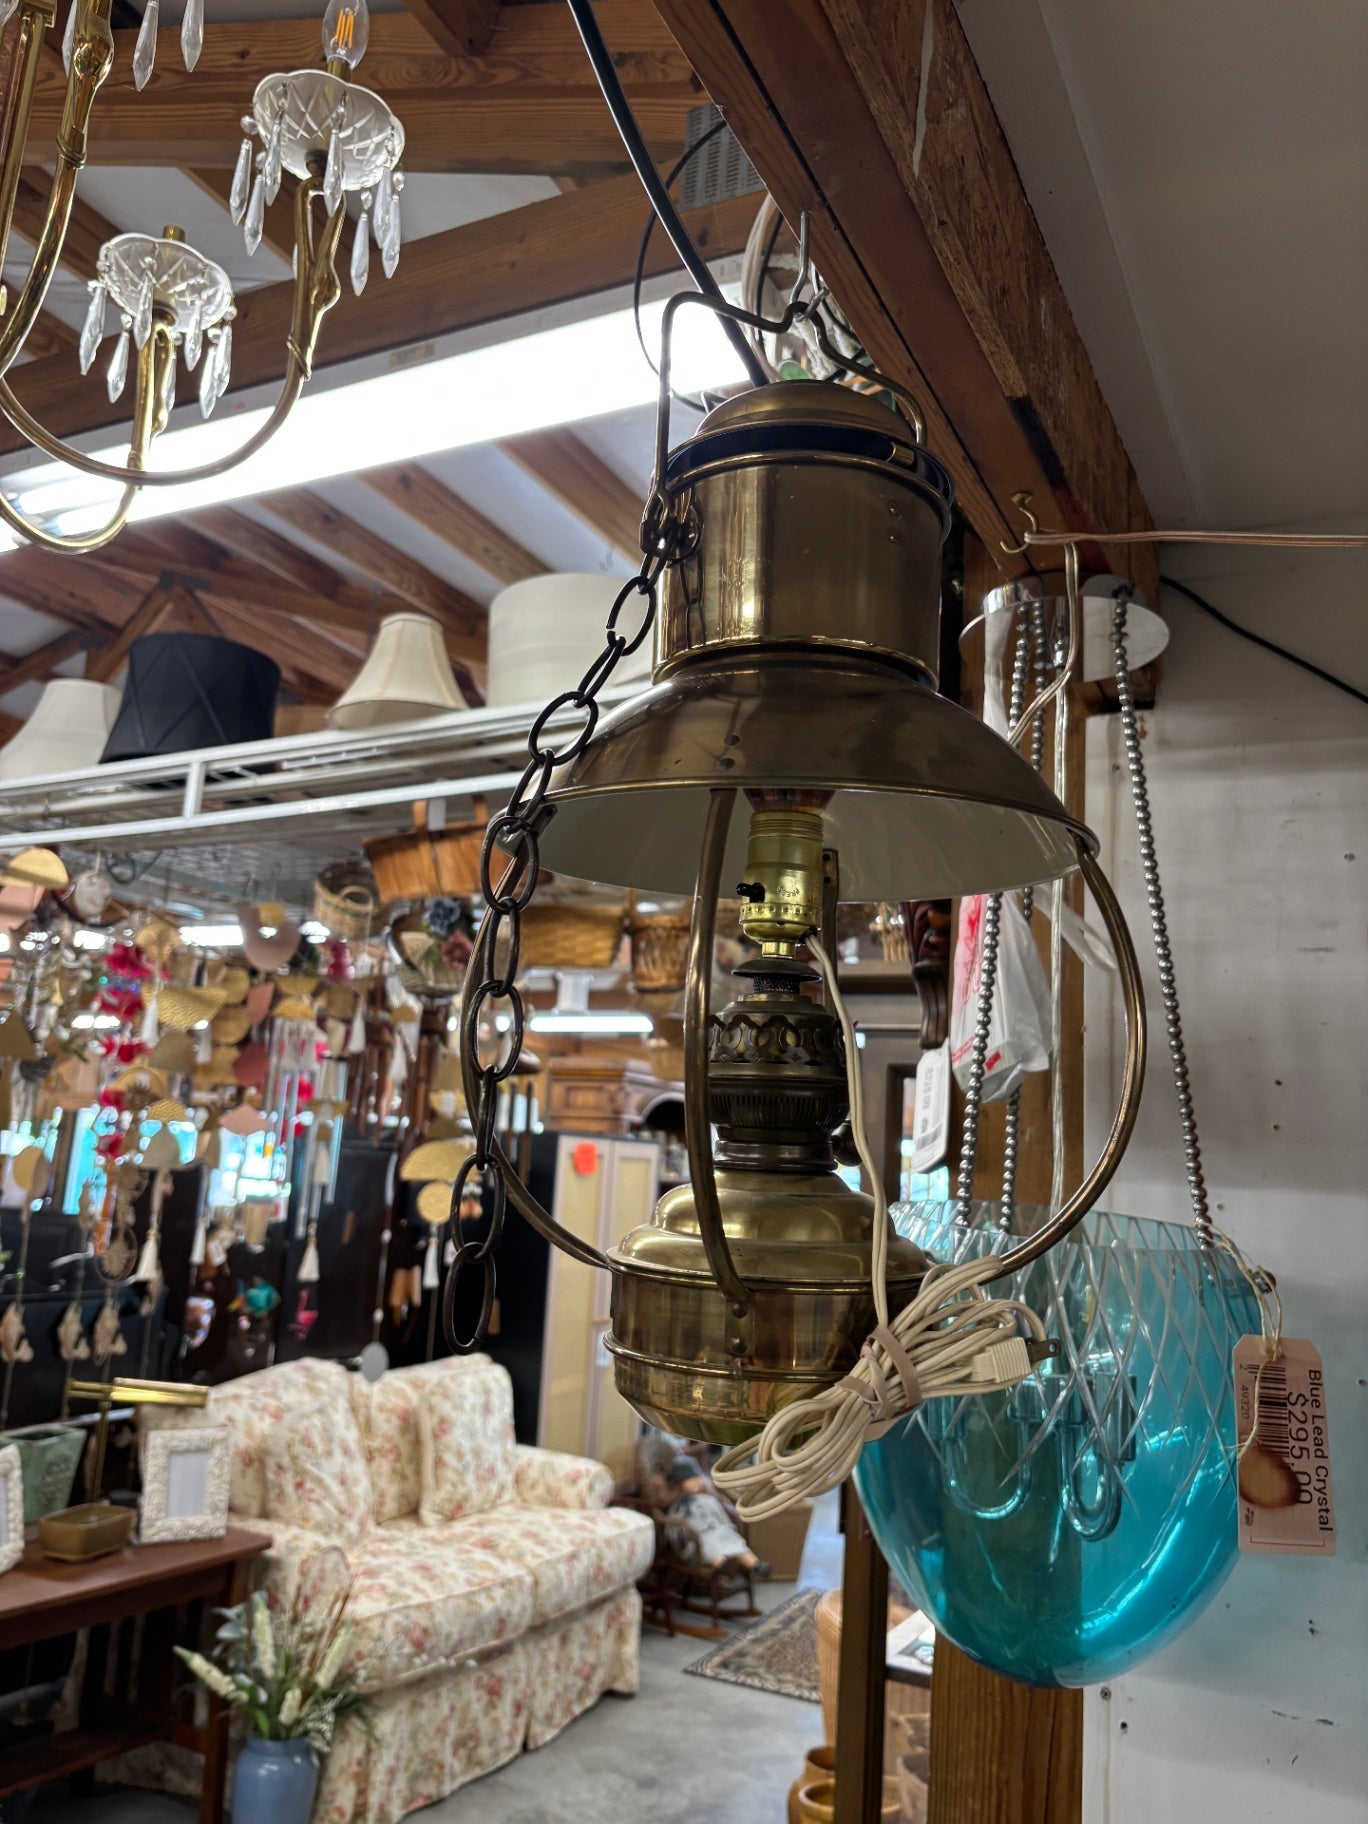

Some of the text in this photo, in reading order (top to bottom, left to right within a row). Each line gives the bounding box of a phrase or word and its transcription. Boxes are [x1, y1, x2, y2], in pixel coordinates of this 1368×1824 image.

[1286, 1391, 1313, 1505] $295.00
[1308, 1369, 1334, 1531] Blue Lead Crystal
